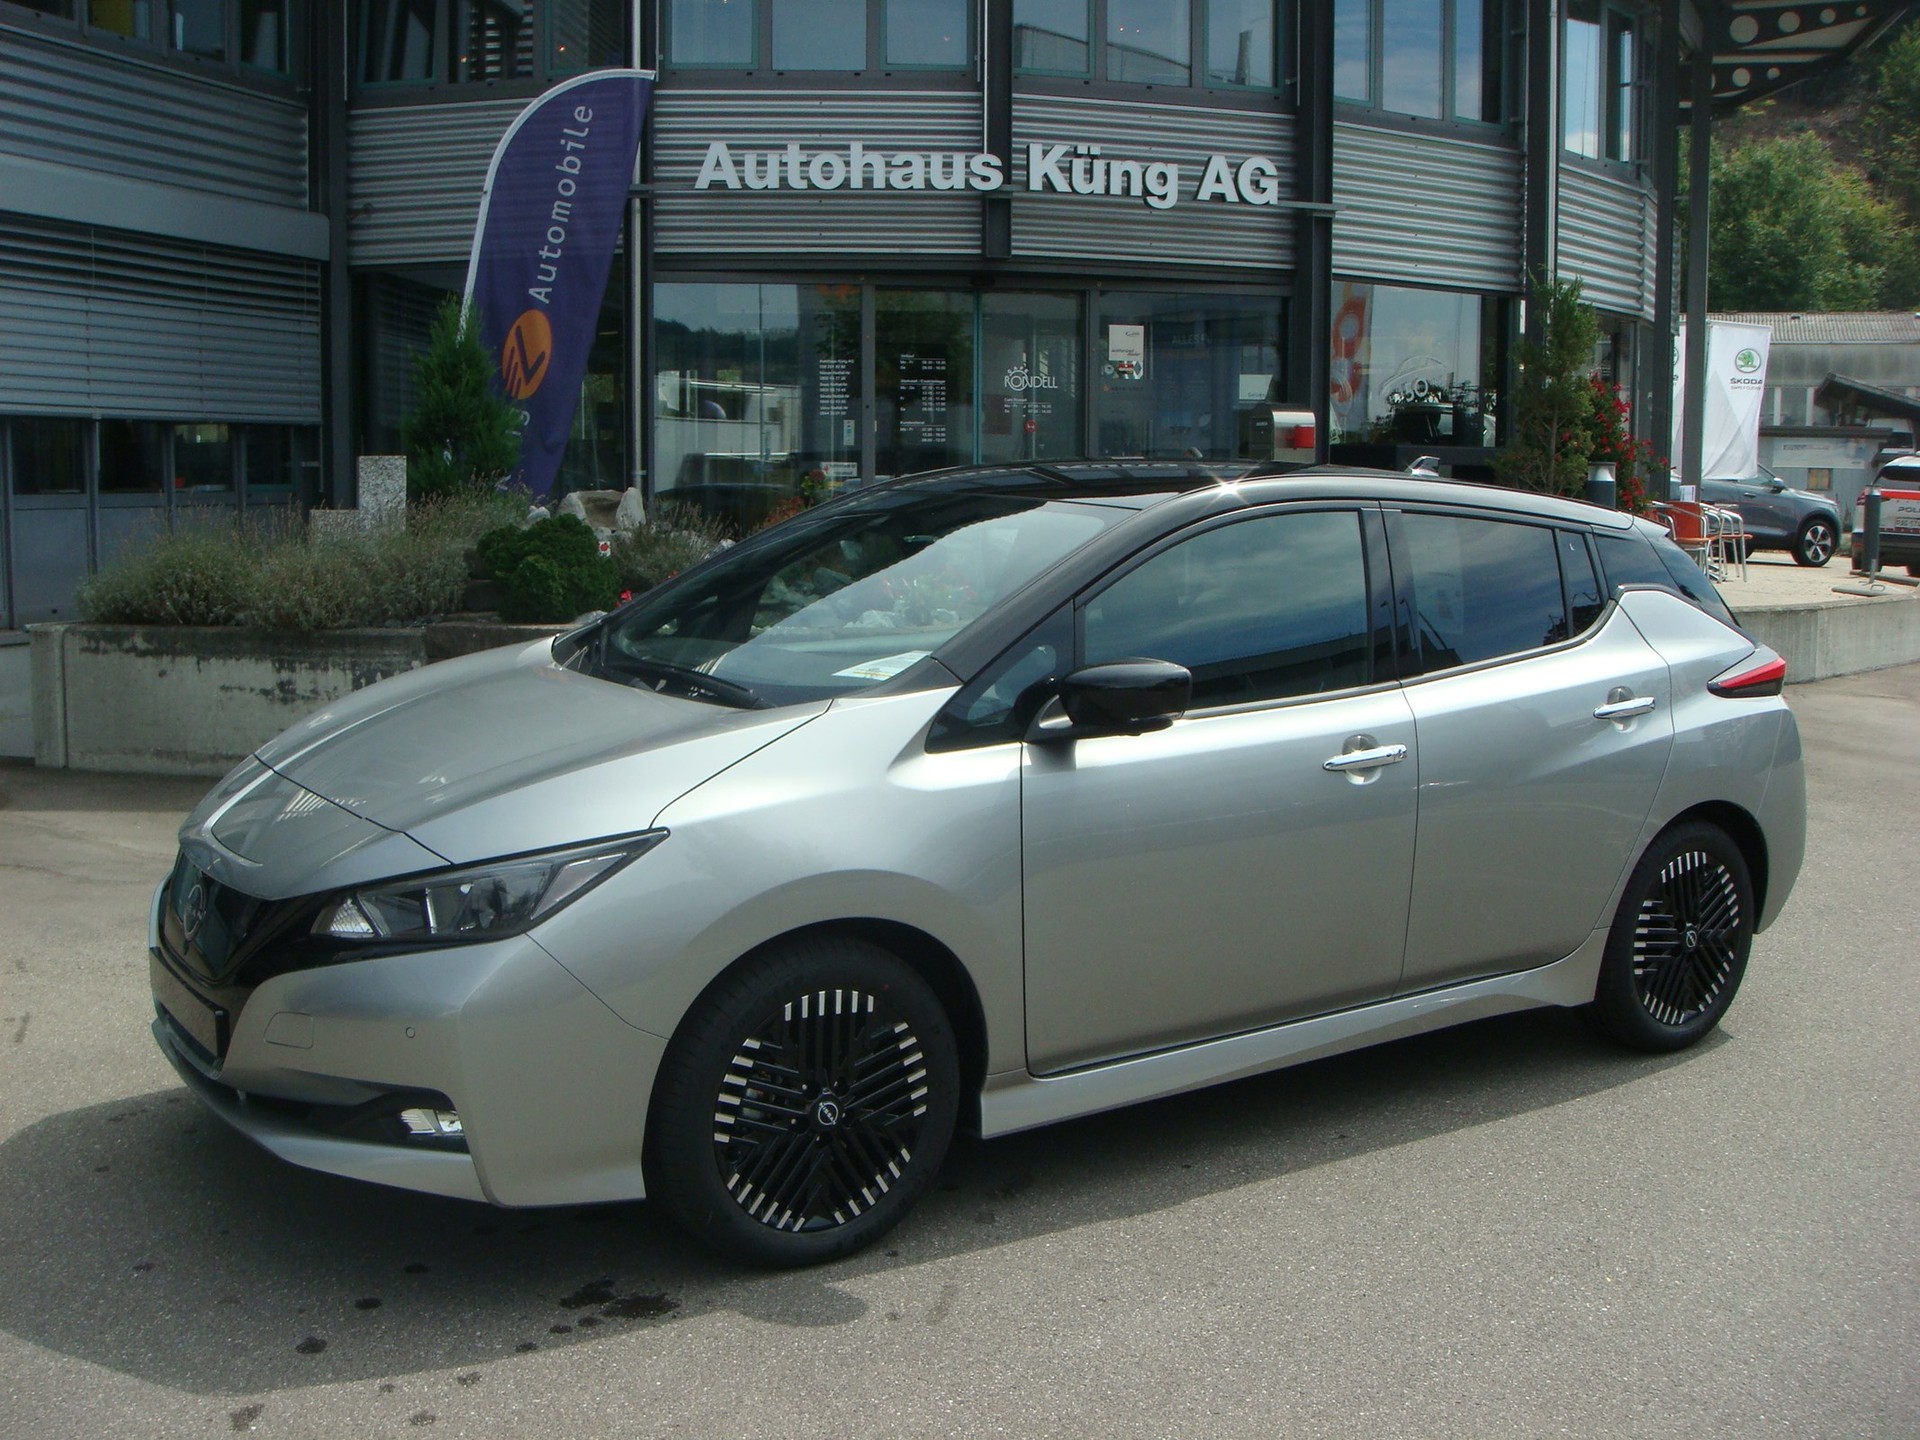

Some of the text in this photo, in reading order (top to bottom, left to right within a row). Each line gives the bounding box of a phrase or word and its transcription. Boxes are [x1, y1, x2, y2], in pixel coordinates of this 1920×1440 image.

[528, 105, 593, 304] Automobile
[694, 141, 1279, 210] Autohaus Küng AG
[1004, 374, 1058, 389] RONDELL
